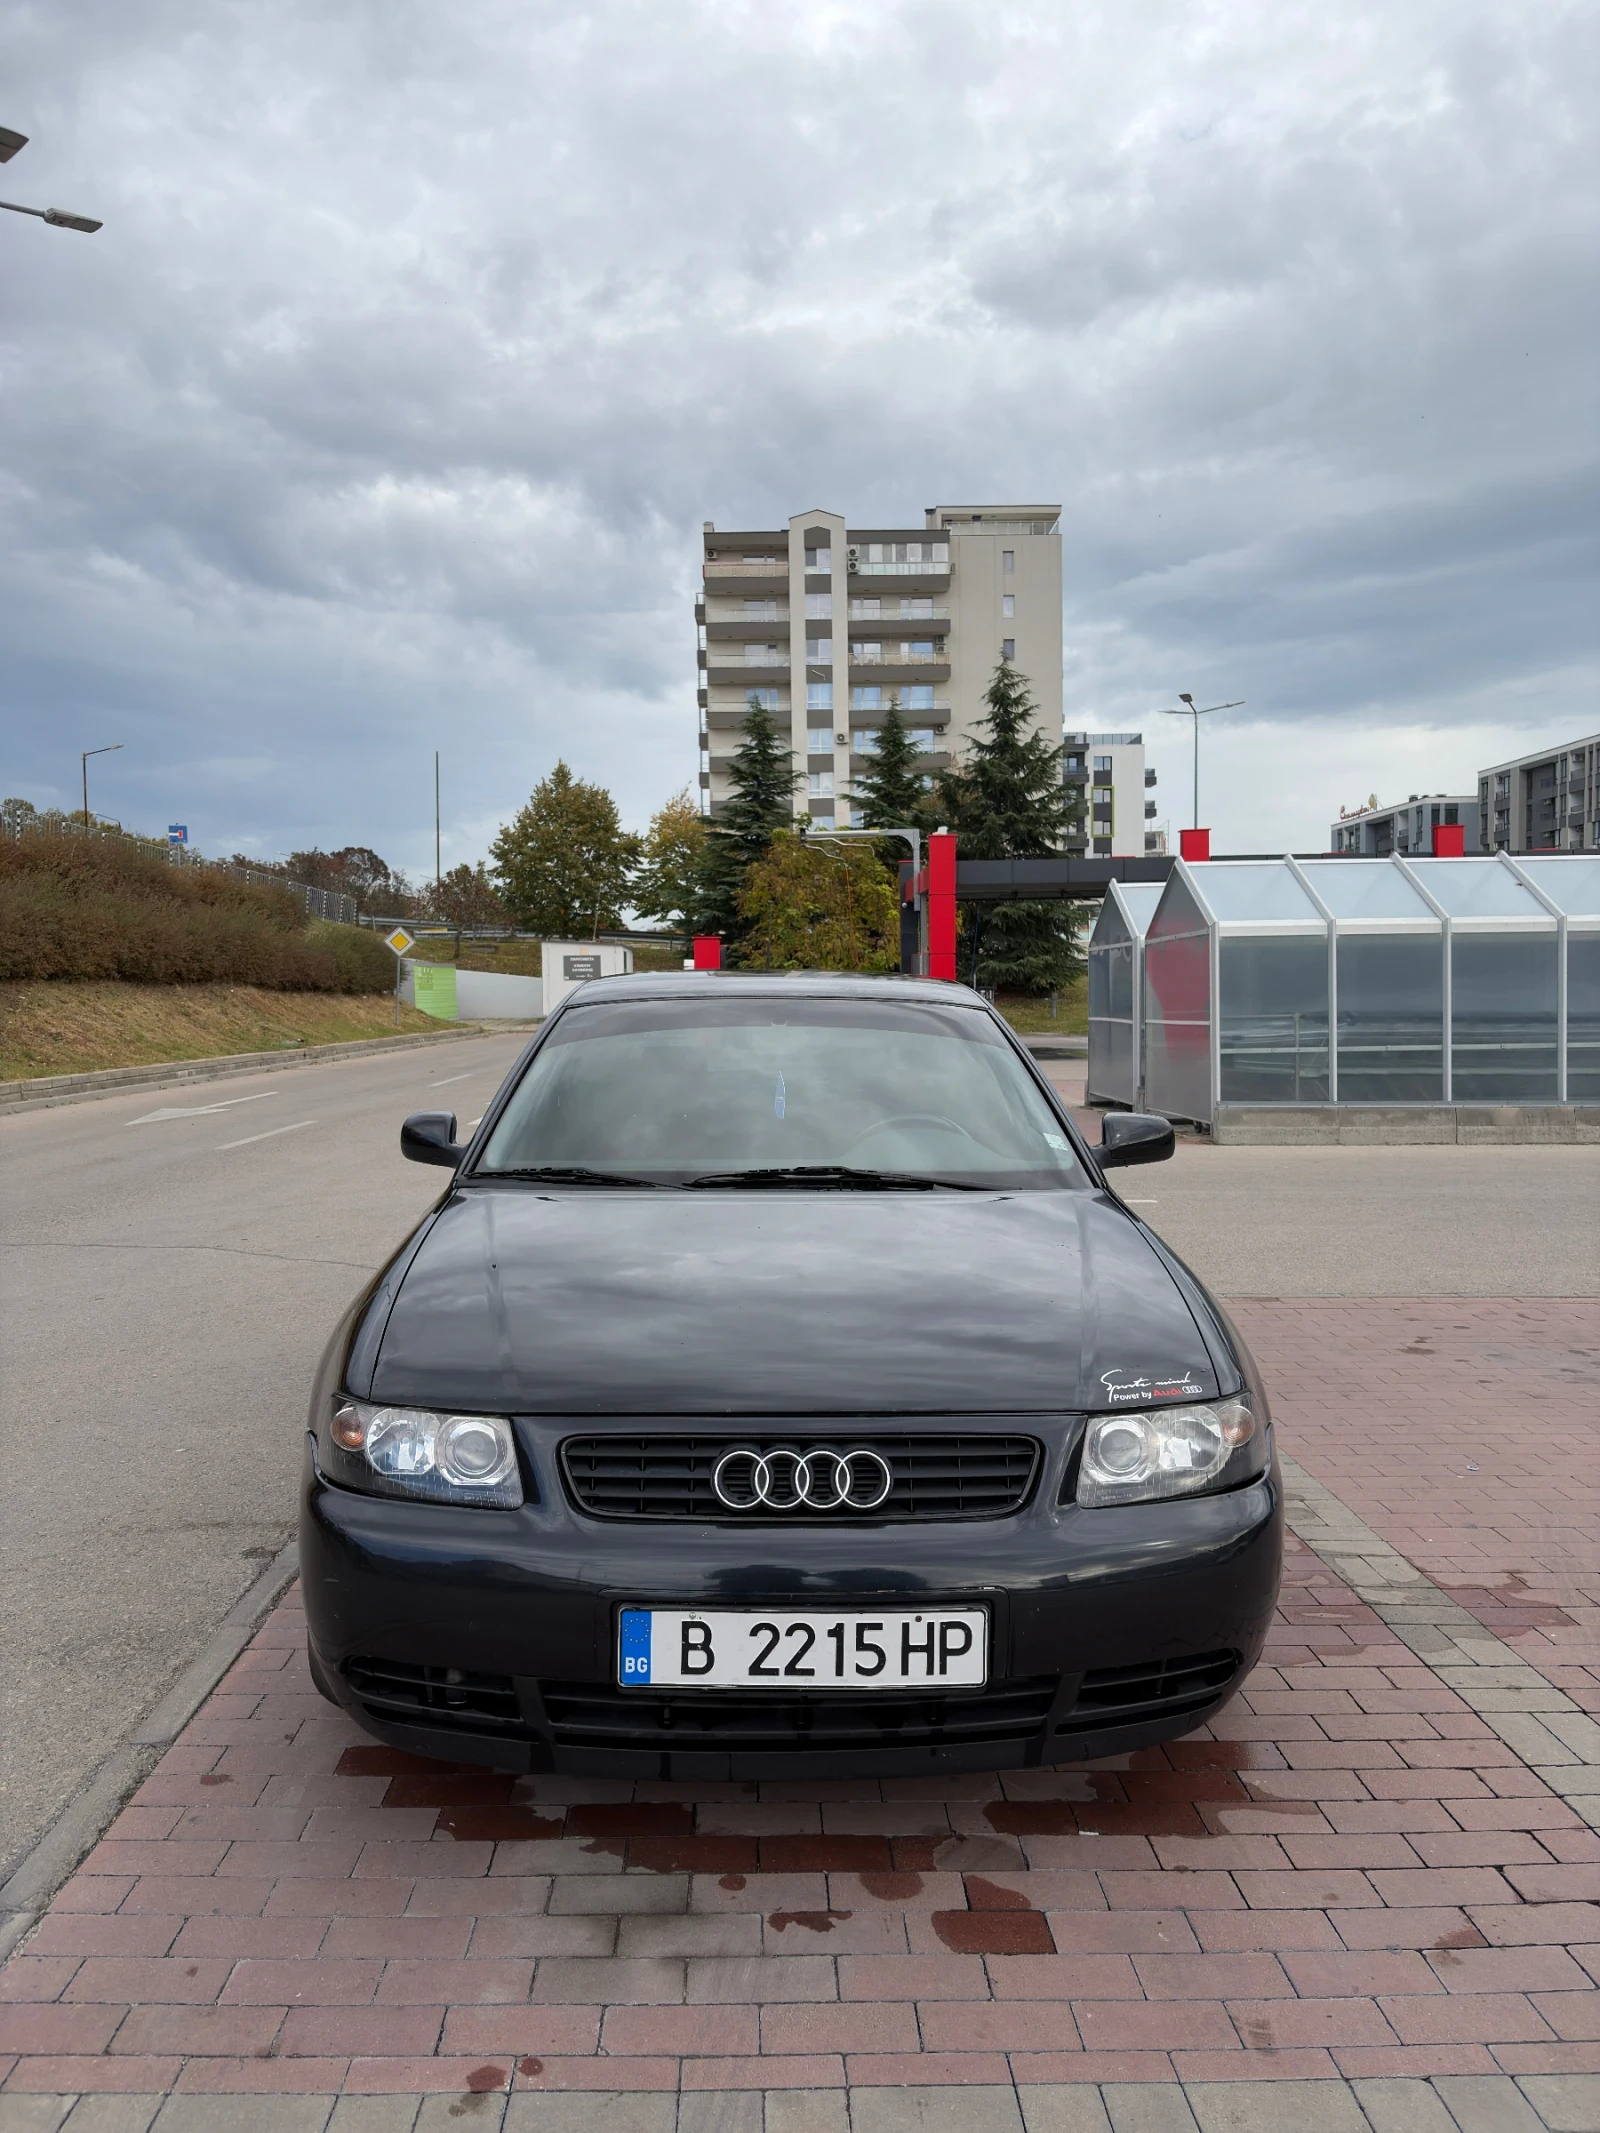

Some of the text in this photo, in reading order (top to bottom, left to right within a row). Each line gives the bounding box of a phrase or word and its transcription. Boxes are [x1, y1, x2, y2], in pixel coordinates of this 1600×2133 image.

[1114, 1387, 1182, 1401] Power by Audi
[680, 1620, 973, 1677] B 2215 HP
[624, 1657, 648, 1674] BG
